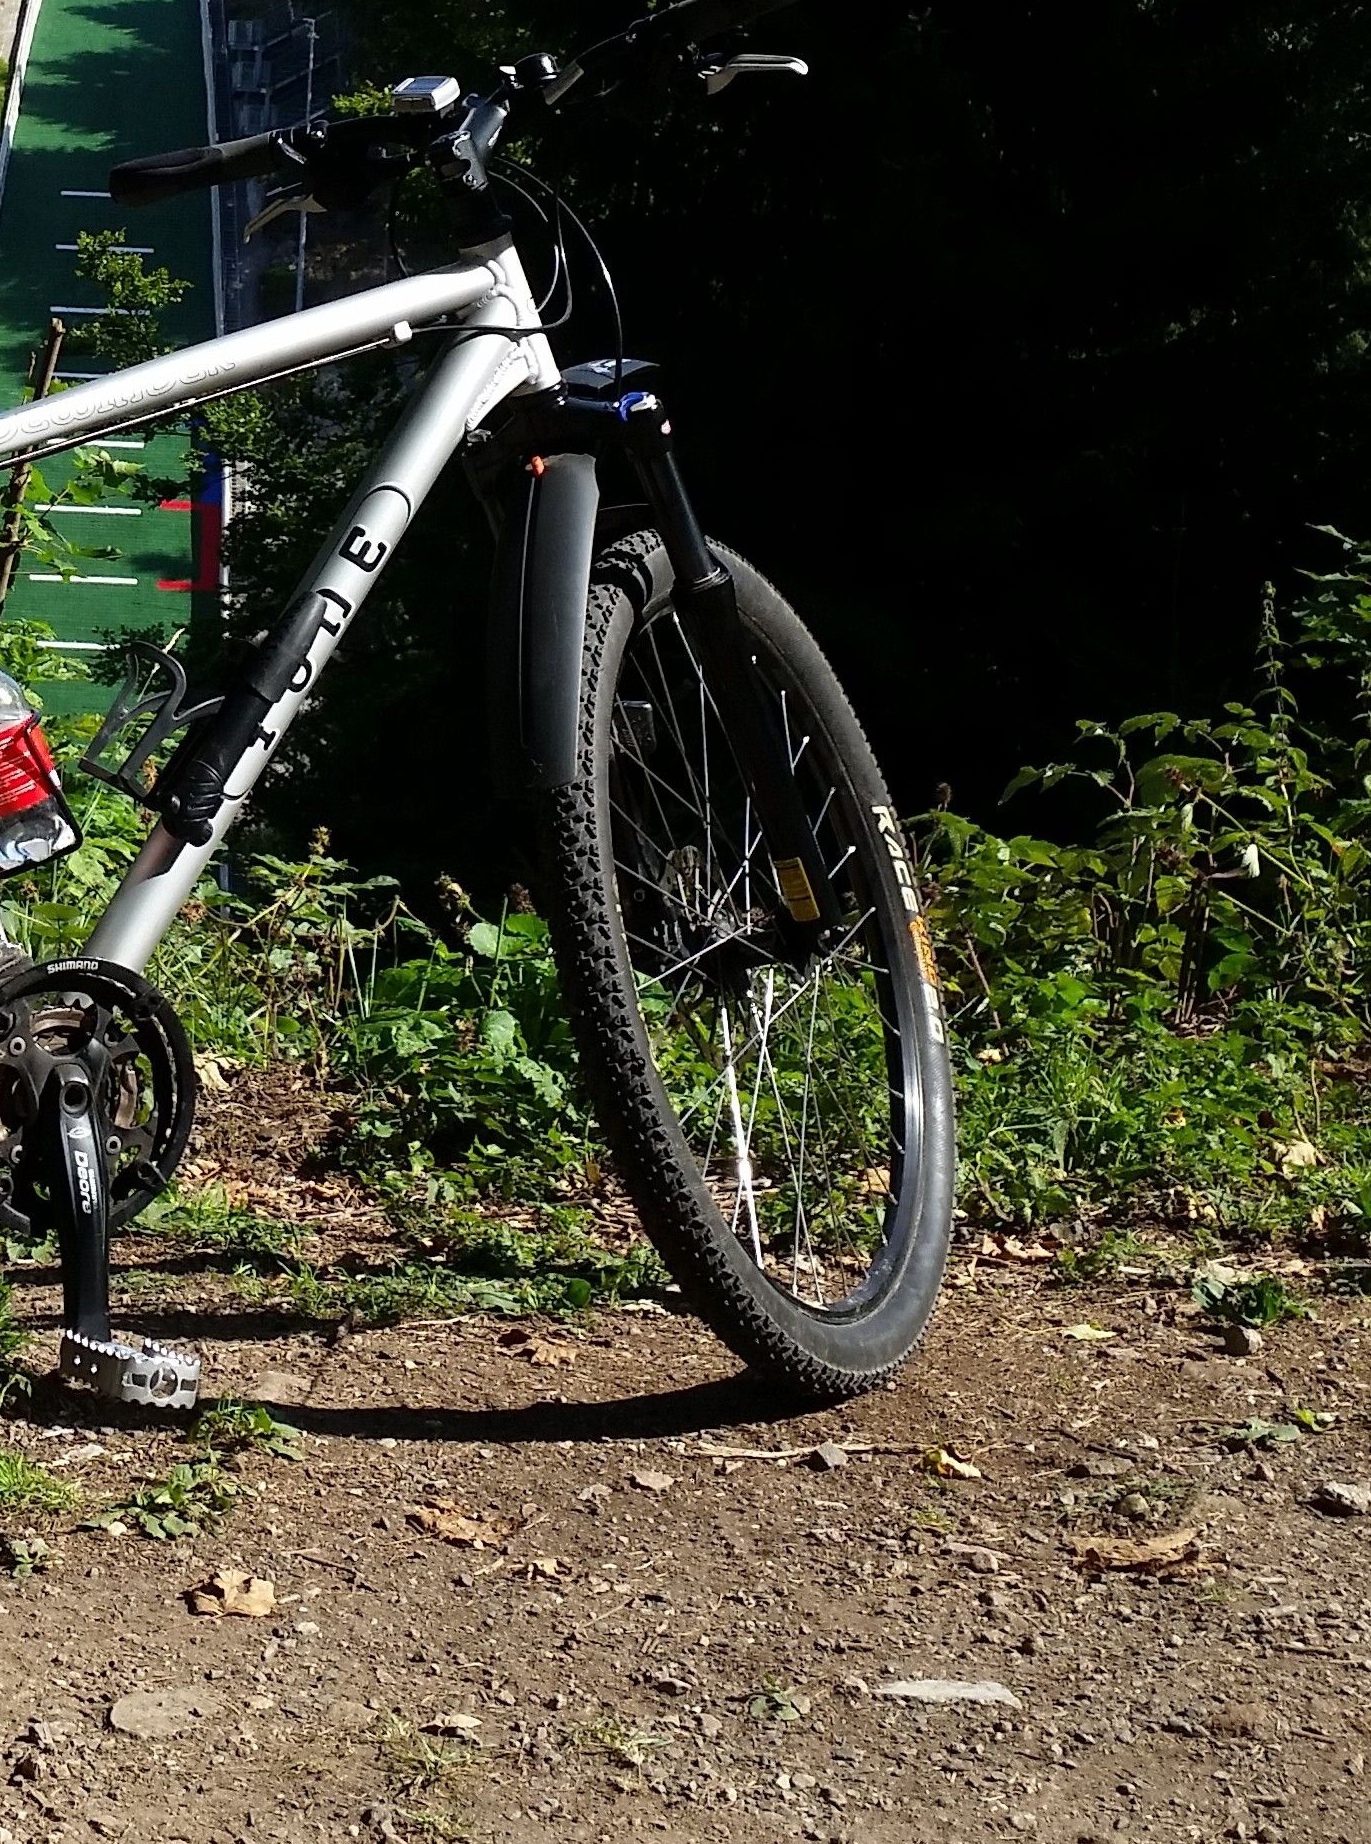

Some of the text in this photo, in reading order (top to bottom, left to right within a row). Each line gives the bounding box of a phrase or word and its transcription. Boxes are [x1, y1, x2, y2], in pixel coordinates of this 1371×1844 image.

[871, 805, 920, 913] RACE
[46, 960, 99, 975] SHIMANO
[74, 1150, 92, 1214] Deore
